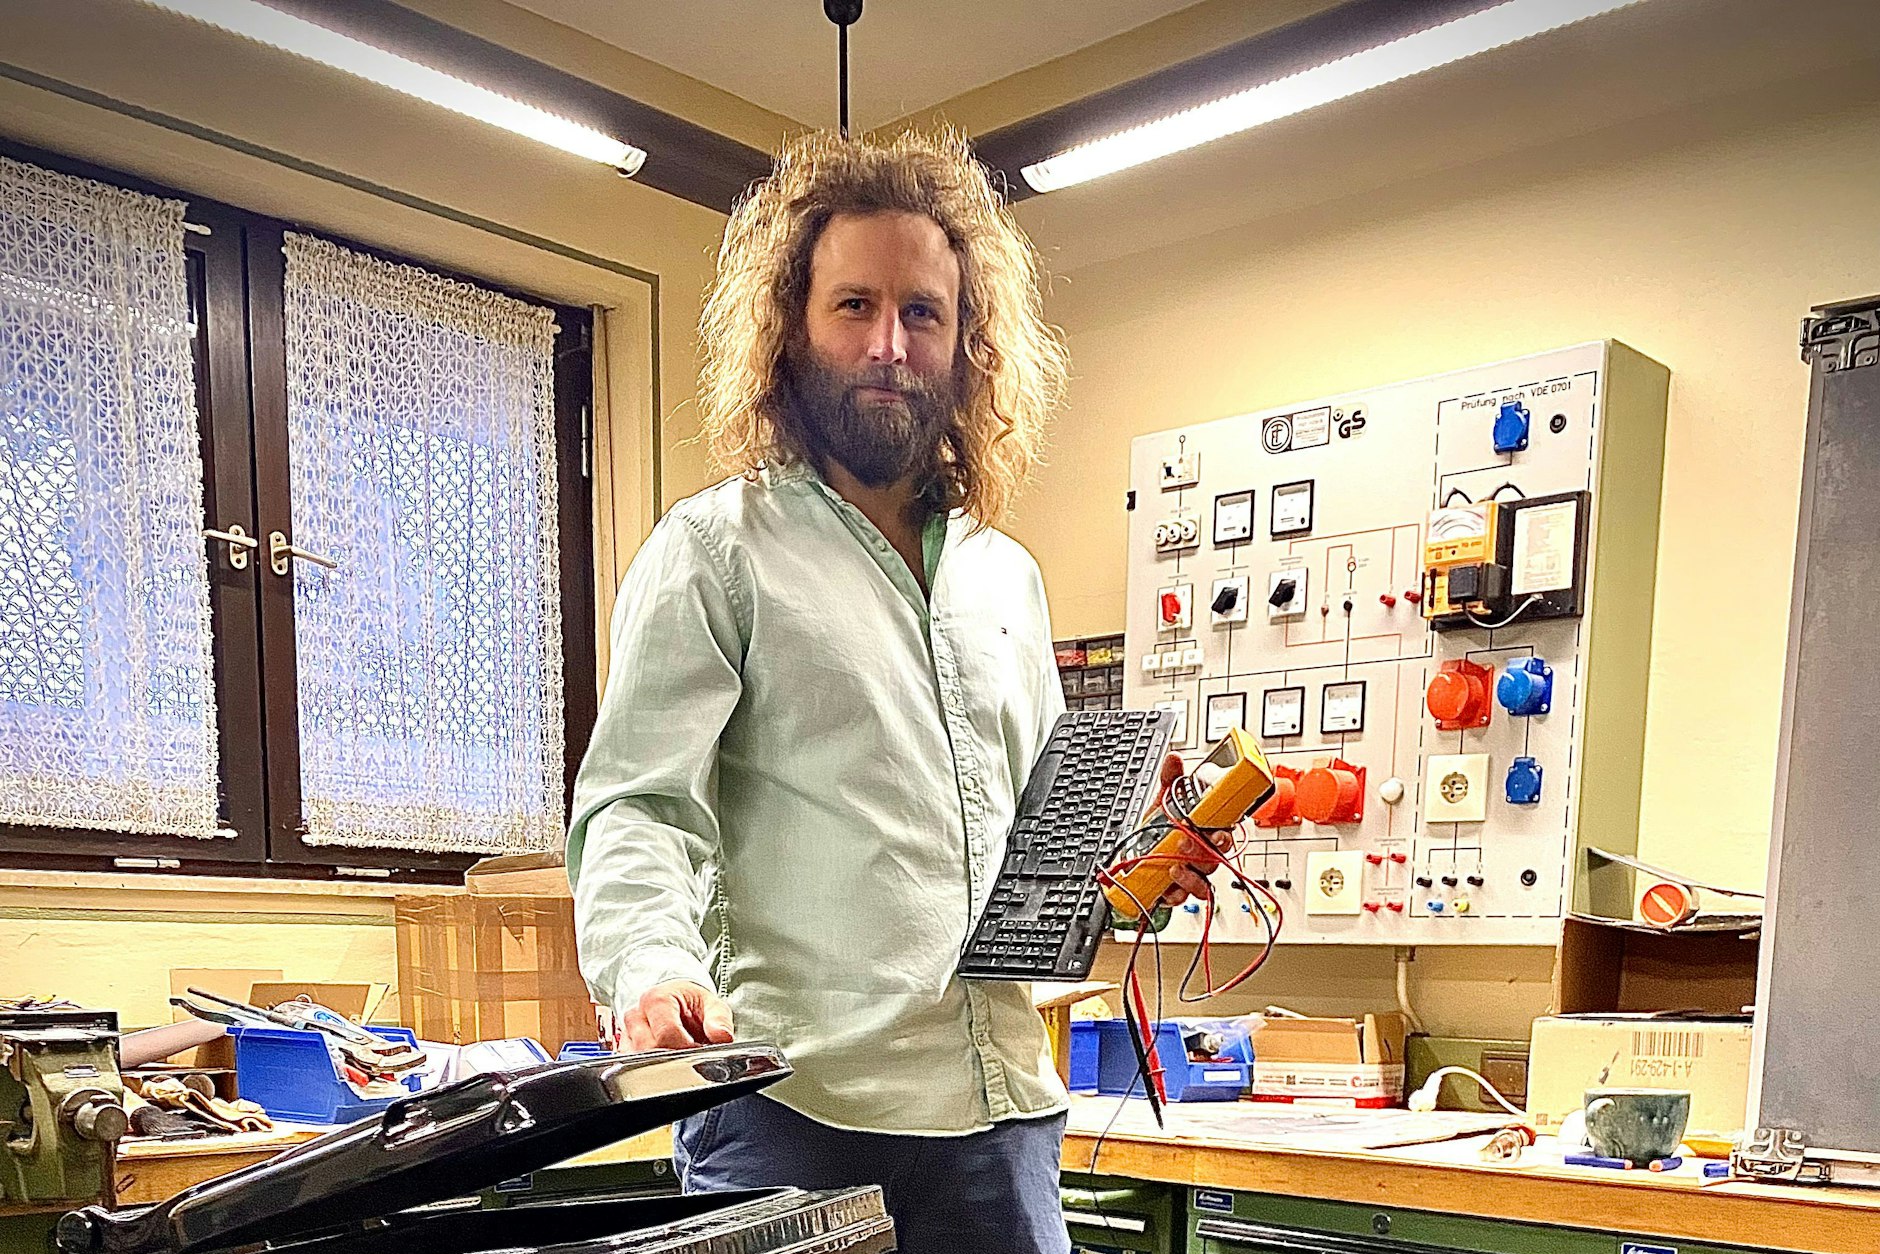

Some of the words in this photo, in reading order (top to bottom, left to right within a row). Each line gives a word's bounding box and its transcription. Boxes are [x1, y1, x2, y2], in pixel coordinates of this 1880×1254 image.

[1502, 391, 1525, 403] nach
[1530, 385, 1549, 397] VDE
[1338, 409, 1366, 438] GS
